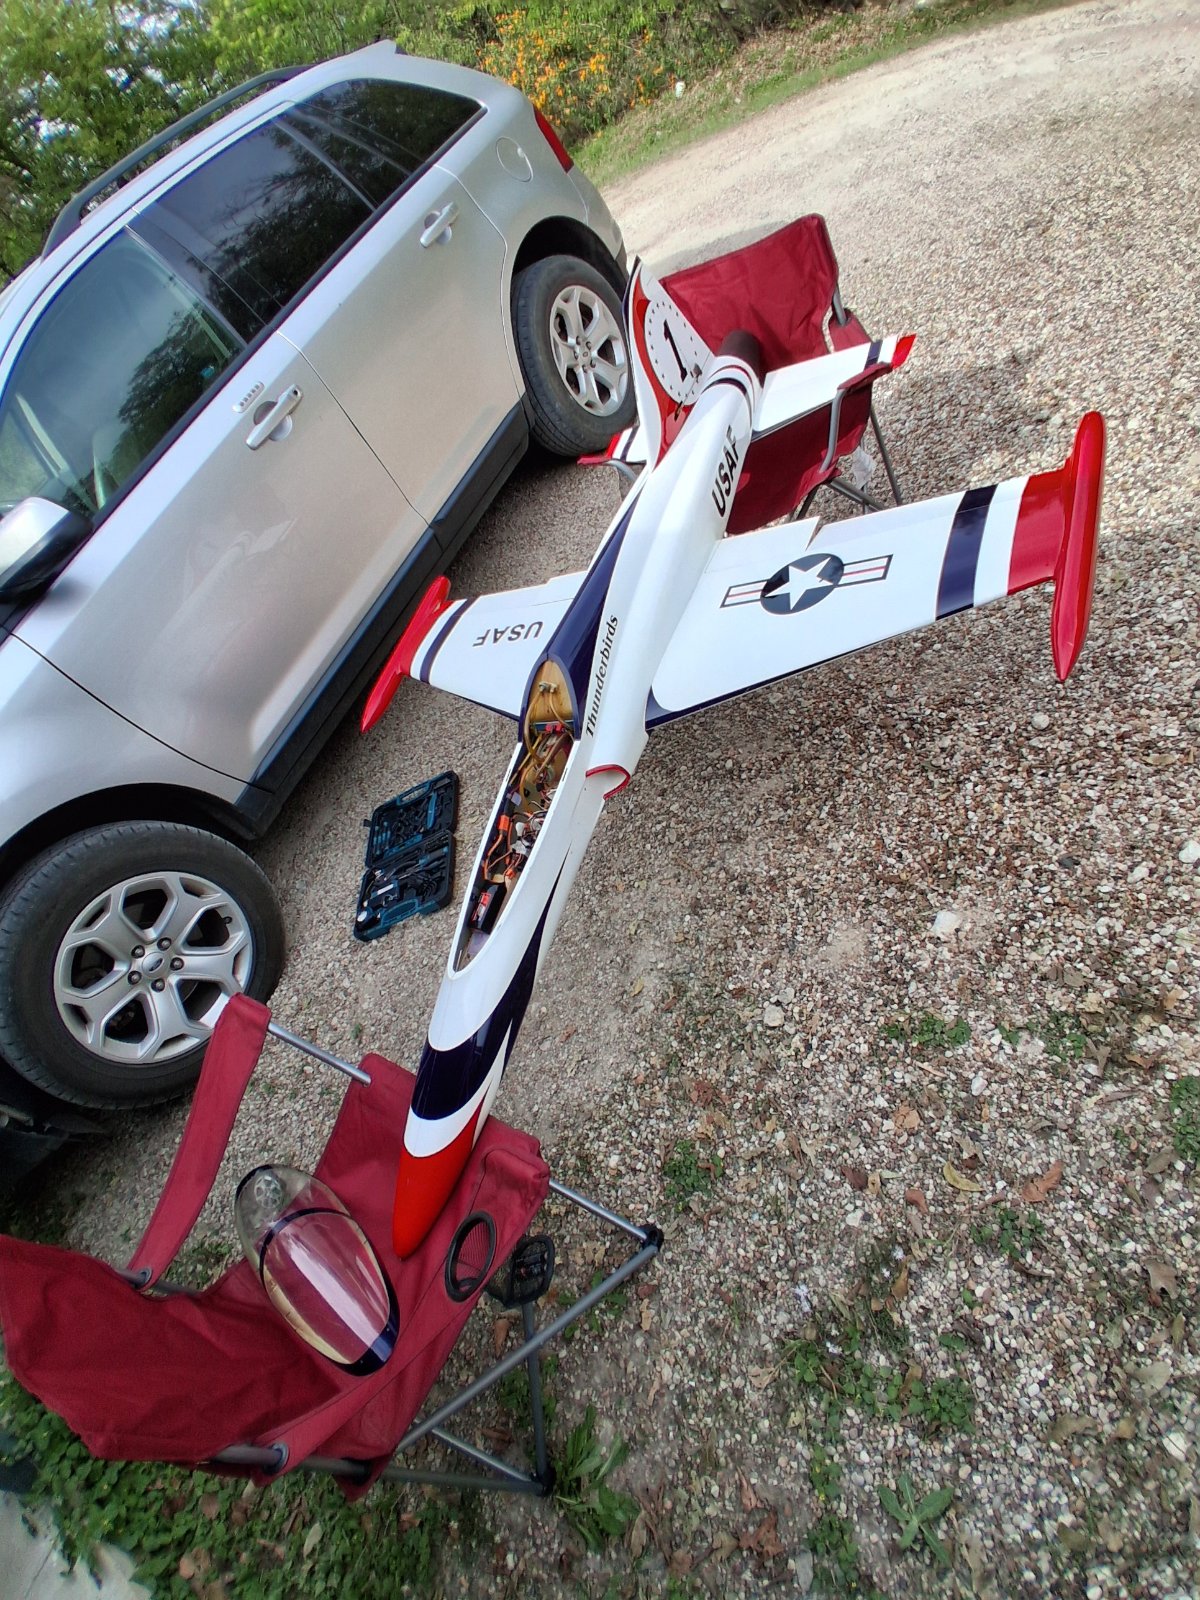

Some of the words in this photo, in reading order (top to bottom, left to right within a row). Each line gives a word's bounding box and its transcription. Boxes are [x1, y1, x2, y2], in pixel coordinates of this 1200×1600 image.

[663, 318, 688, 382] 1
[711, 425, 739, 517] USAF
[472, 621, 543, 647] USAF
[585, 614, 619, 738] Thunderbirds
